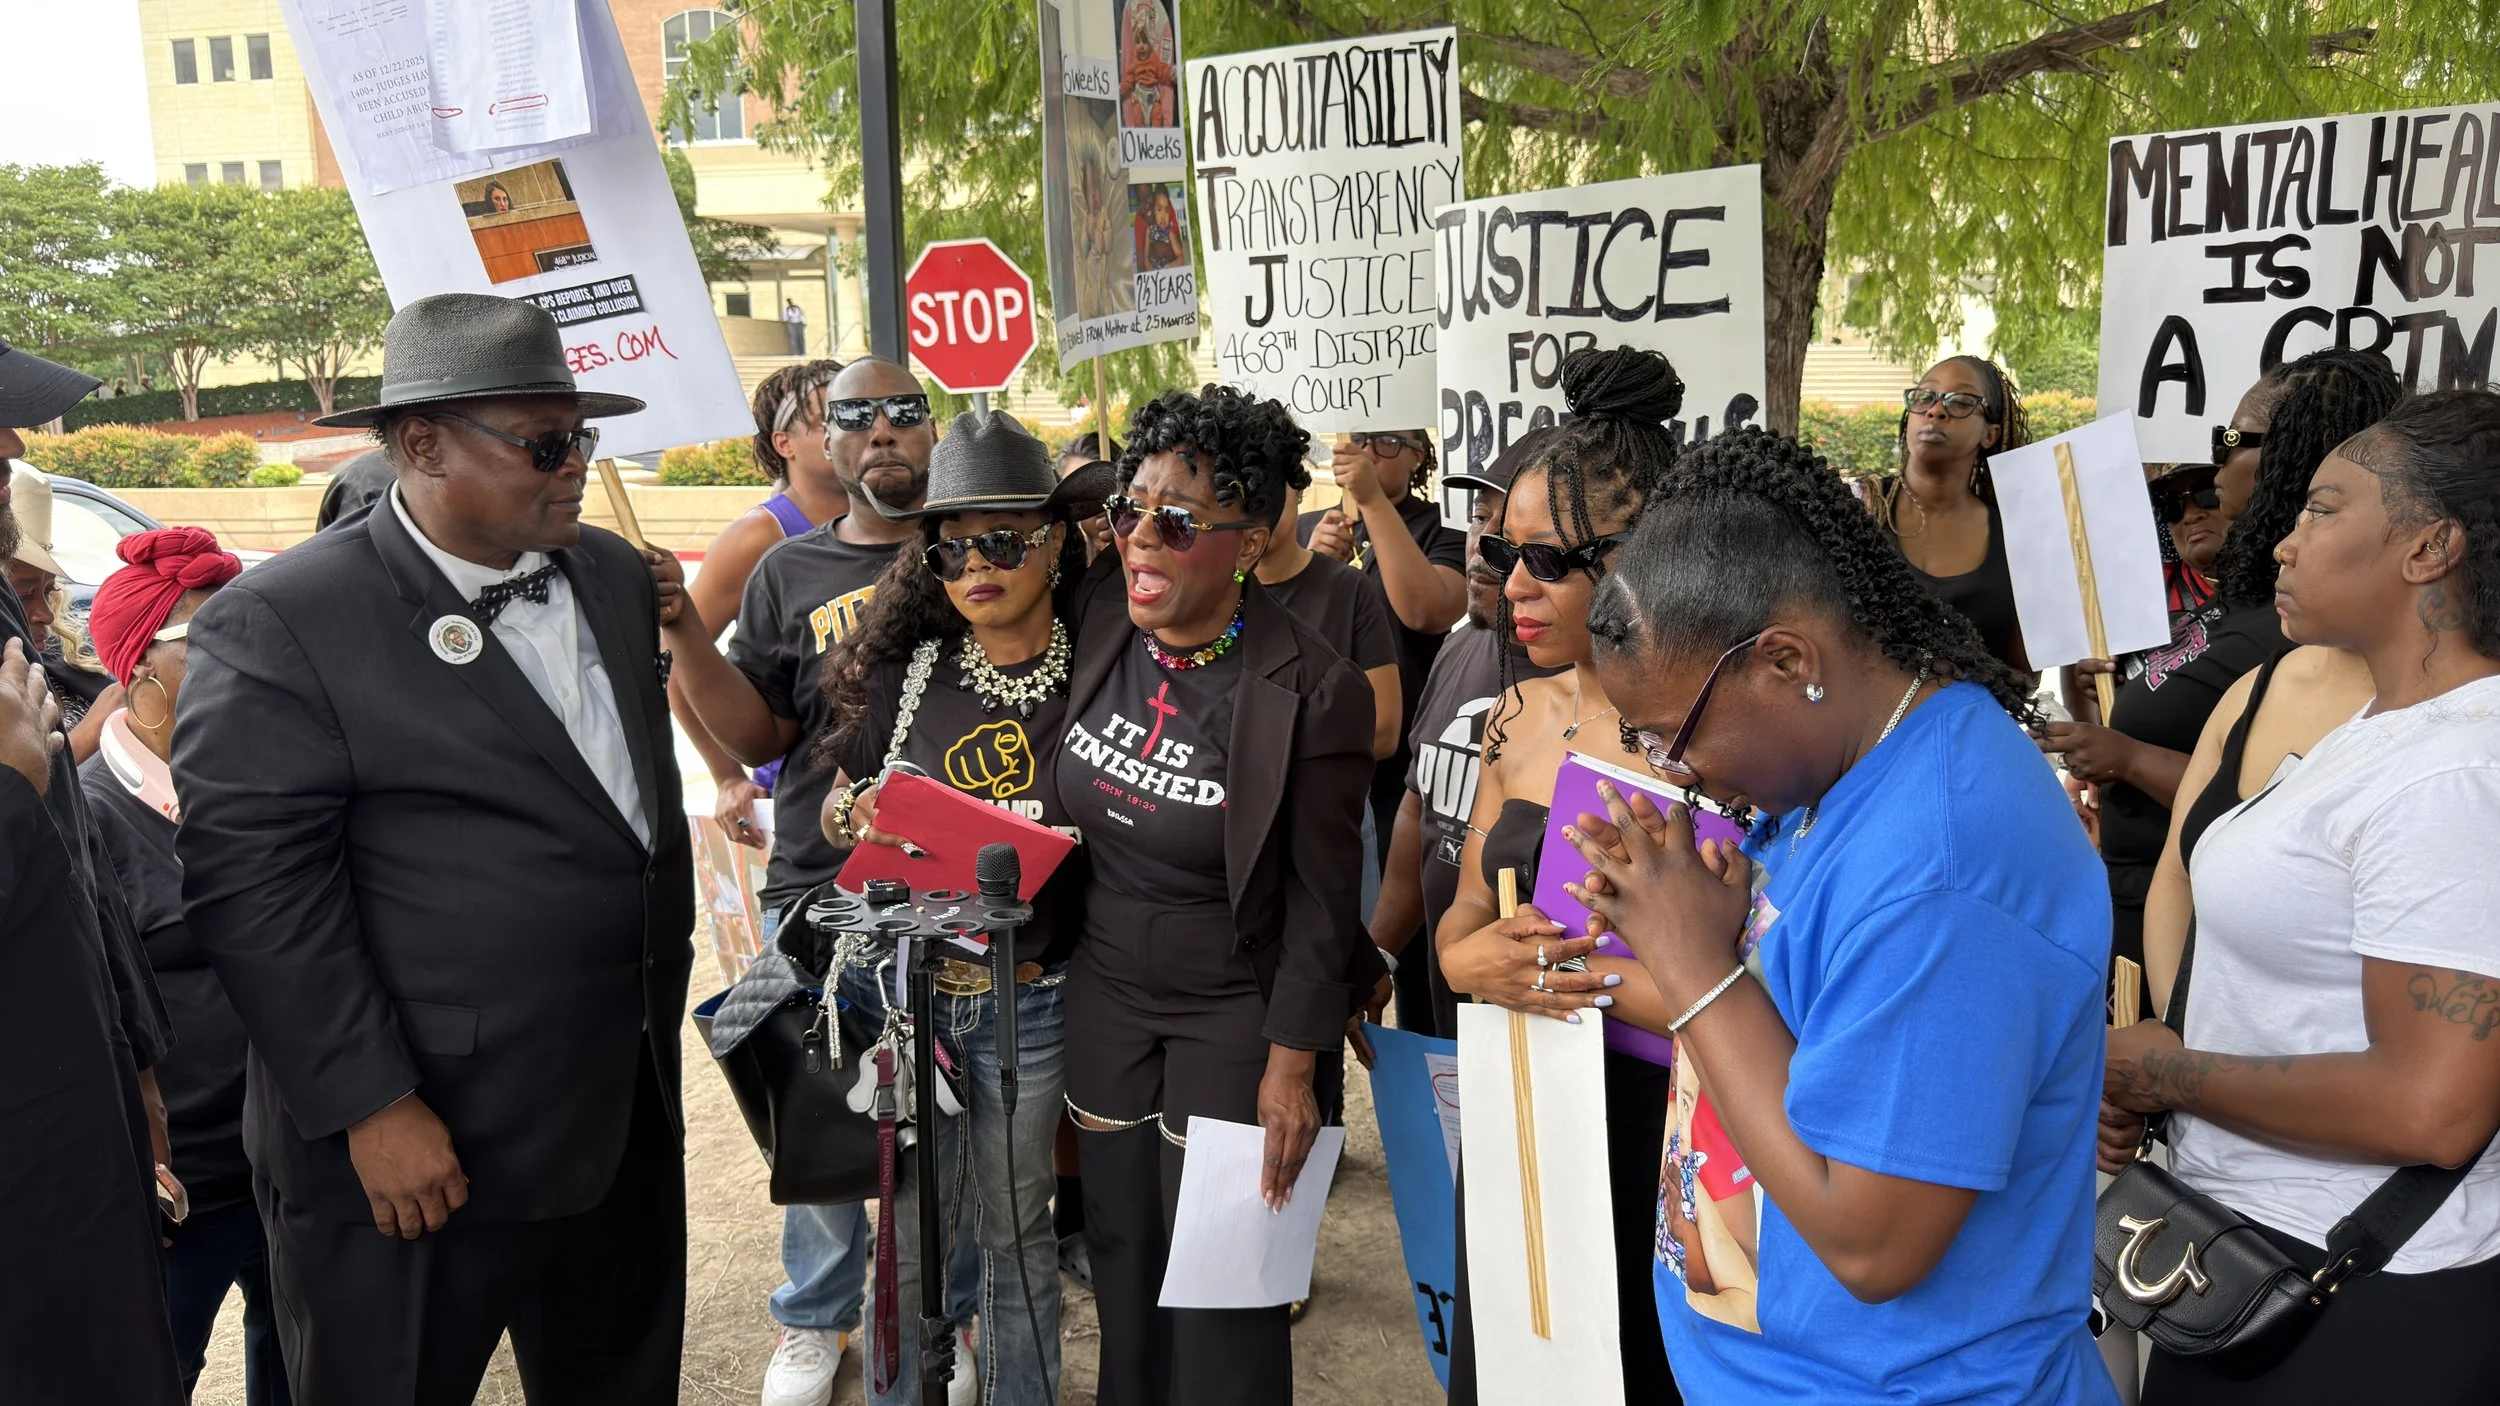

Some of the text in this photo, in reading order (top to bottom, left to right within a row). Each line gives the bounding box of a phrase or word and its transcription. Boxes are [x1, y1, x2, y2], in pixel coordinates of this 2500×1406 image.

[350, 86, 374, 99] 1400+
[376, 75, 411, 94] JUDGES
[353, 73, 364, 83] AS
[365, 69, 378, 80] OF
[357, 87, 426, 113] BEEN ACCUSED
[1197, 37, 1453, 161] ACCOUTABILITY
[373, 102, 431, 124] CHILD ABUS
[1197, 156, 1461, 251] TRANSPARENCY
[2108, 119, 2359, 246] MENTAL
[1246, 247, 1437, 327] JUSTICE
[1436, 206, 1732, 330] JUSTICE
[2203, 222, 2500, 306] IS NOT
[539, 295, 556, 309] CPS
[555, 288, 594, 304] REPORTS,
[592, 284, 611, 298] AND
[610, 279, 633, 294] OVER
[558, 305, 597, 323] CLAIMING
[597, 295, 640, 316] COLLUSION
[911, 288, 1023, 348] STOP
[1223, 330, 1297, 375] 468TH
[2138, 315, 2206, 418] A
[1291, 373, 1393, 416] COURT
[1101, 713, 1194, 768] IT IS
[1093, 778, 1156, 812] JOHN 19:30
